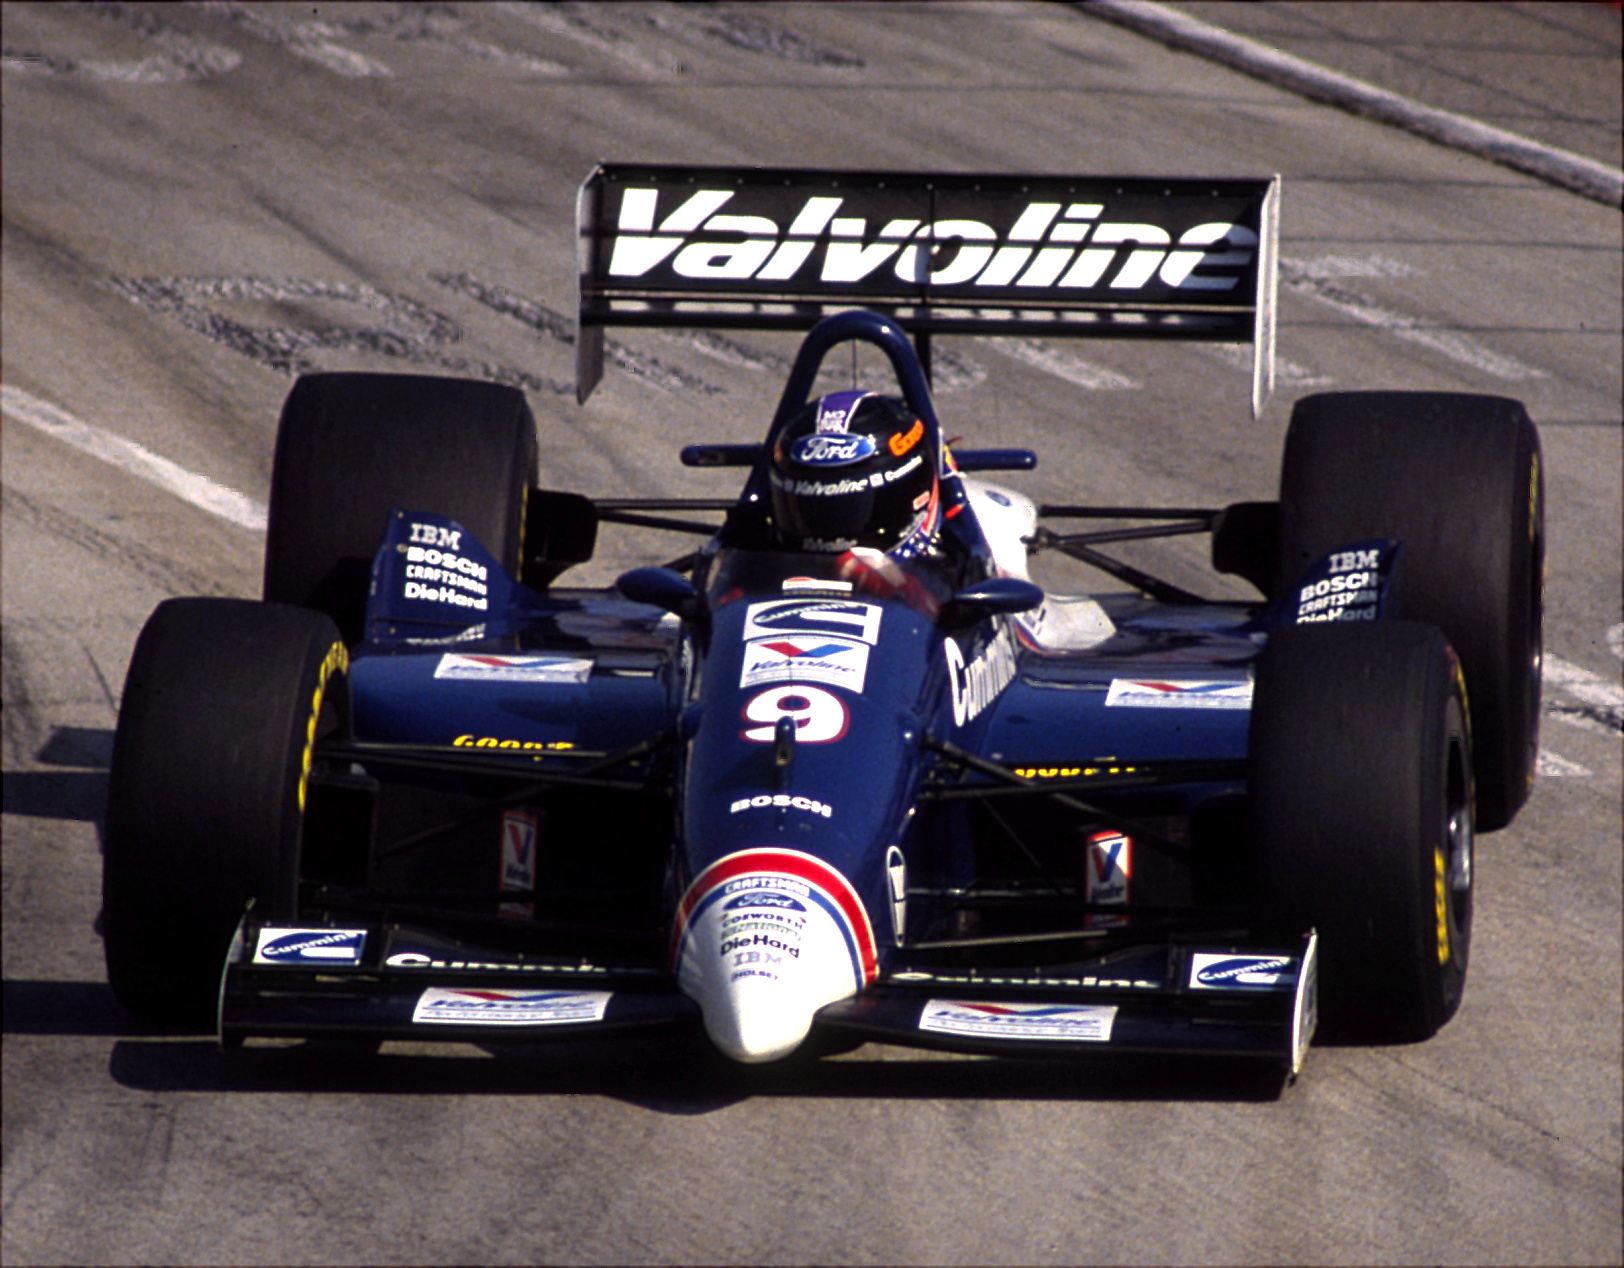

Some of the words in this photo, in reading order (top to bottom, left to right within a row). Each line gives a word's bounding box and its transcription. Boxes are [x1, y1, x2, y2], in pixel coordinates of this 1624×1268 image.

[609, 187, 1259, 290] Valvoline
[801, 437, 859, 461] Ford
[794, 478, 868, 497] Valvoline
[409, 523, 461, 551] IBM
[407, 546, 488, 581] BOSCH
[1329, 549, 1379, 574] IBM
[405, 564, 488, 596] CRAFTSMAN
[1300, 571, 1378, 603] BOSCH
[404, 581, 488, 611] DieHard
[1298, 589, 1378, 616] CRAFTSMAN
[738, 685, 850, 744] 9
[731, 795, 832, 818] BOSCH
[725, 876, 811, 898] CRAFTSMAN
[738, 892, 795, 907] Ford
[720, 934, 800, 959] DieHard
[734, 951, 782, 967] IBM
